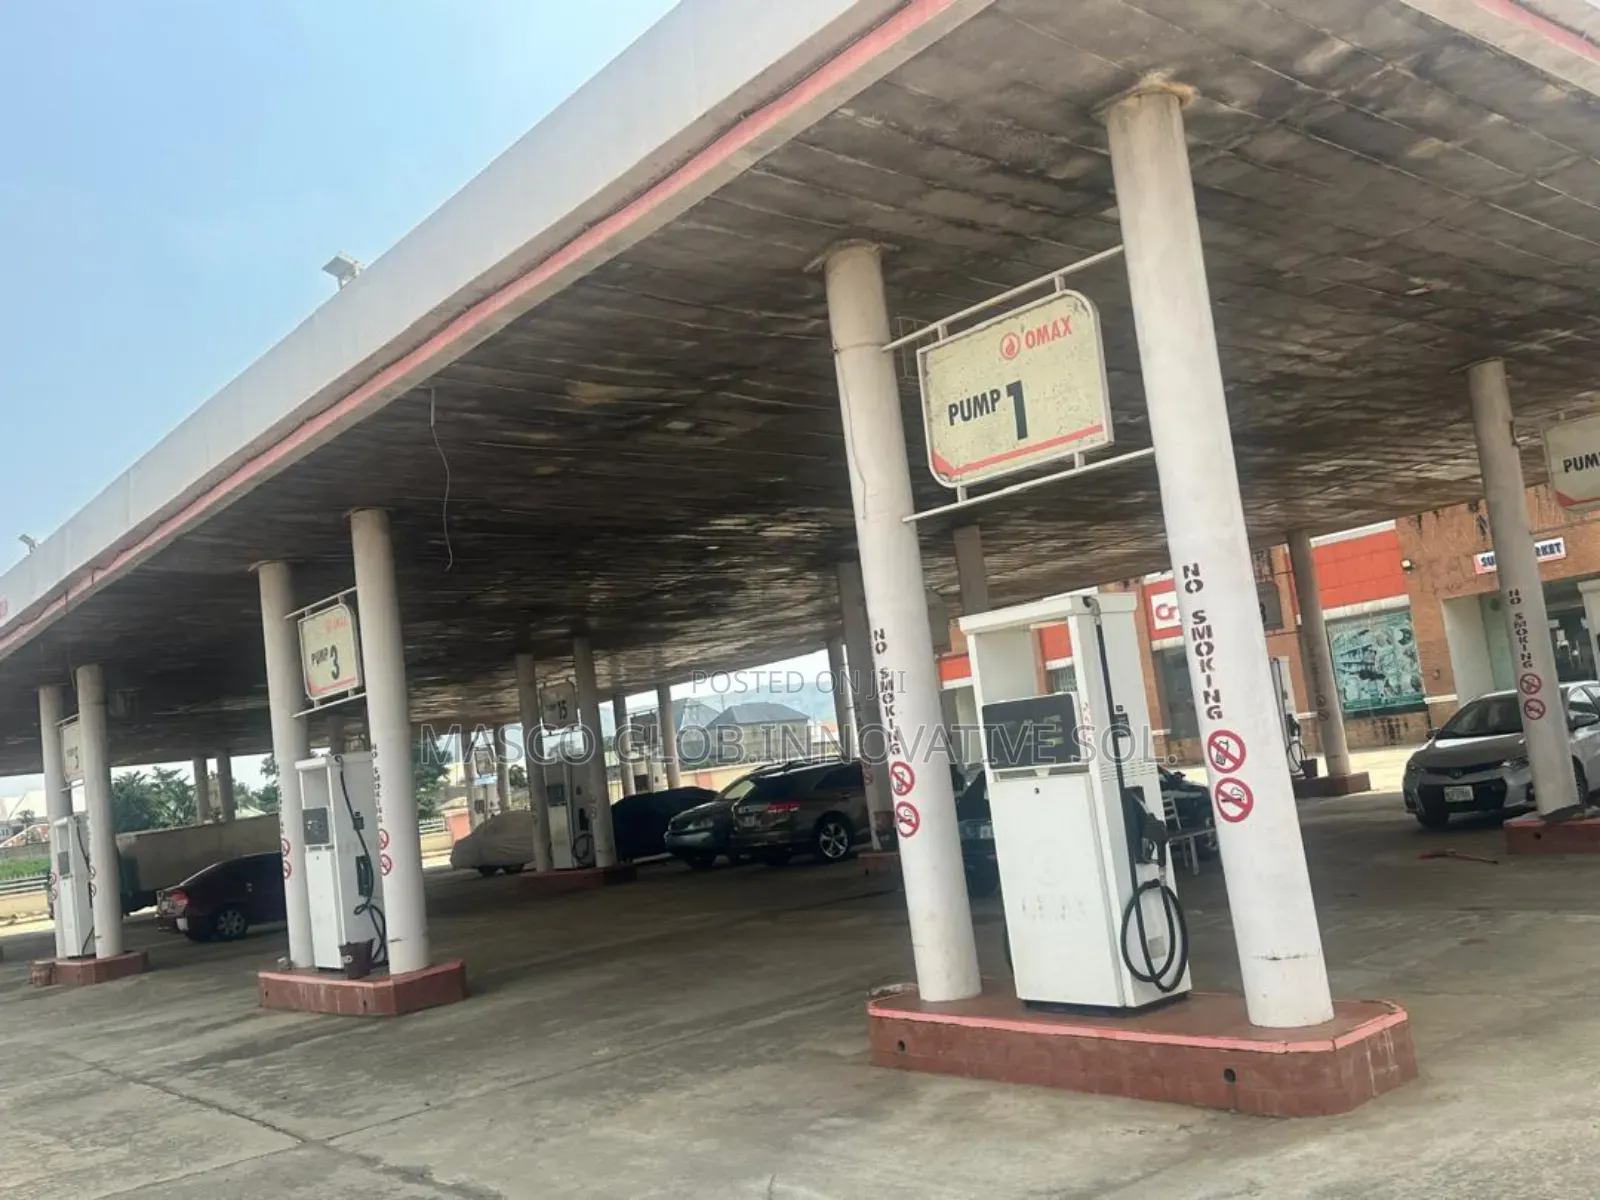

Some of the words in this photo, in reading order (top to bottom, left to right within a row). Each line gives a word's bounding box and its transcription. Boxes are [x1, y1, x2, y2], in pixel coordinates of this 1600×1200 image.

[1025, 315, 1073, 349] OMAX
[948, 388, 1001, 426] PUMP
[1006, 380, 1028, 440] 1
[1563, 451, 1600, 473] PUM
[1182, 562, 1204, 594] NO
[873, 627, 887, 655] NO
[330, 644, 340, 680] 3
[1191, 609, 1223, 720] SMOKING
[879, 666, 901, 755] SMOKING
